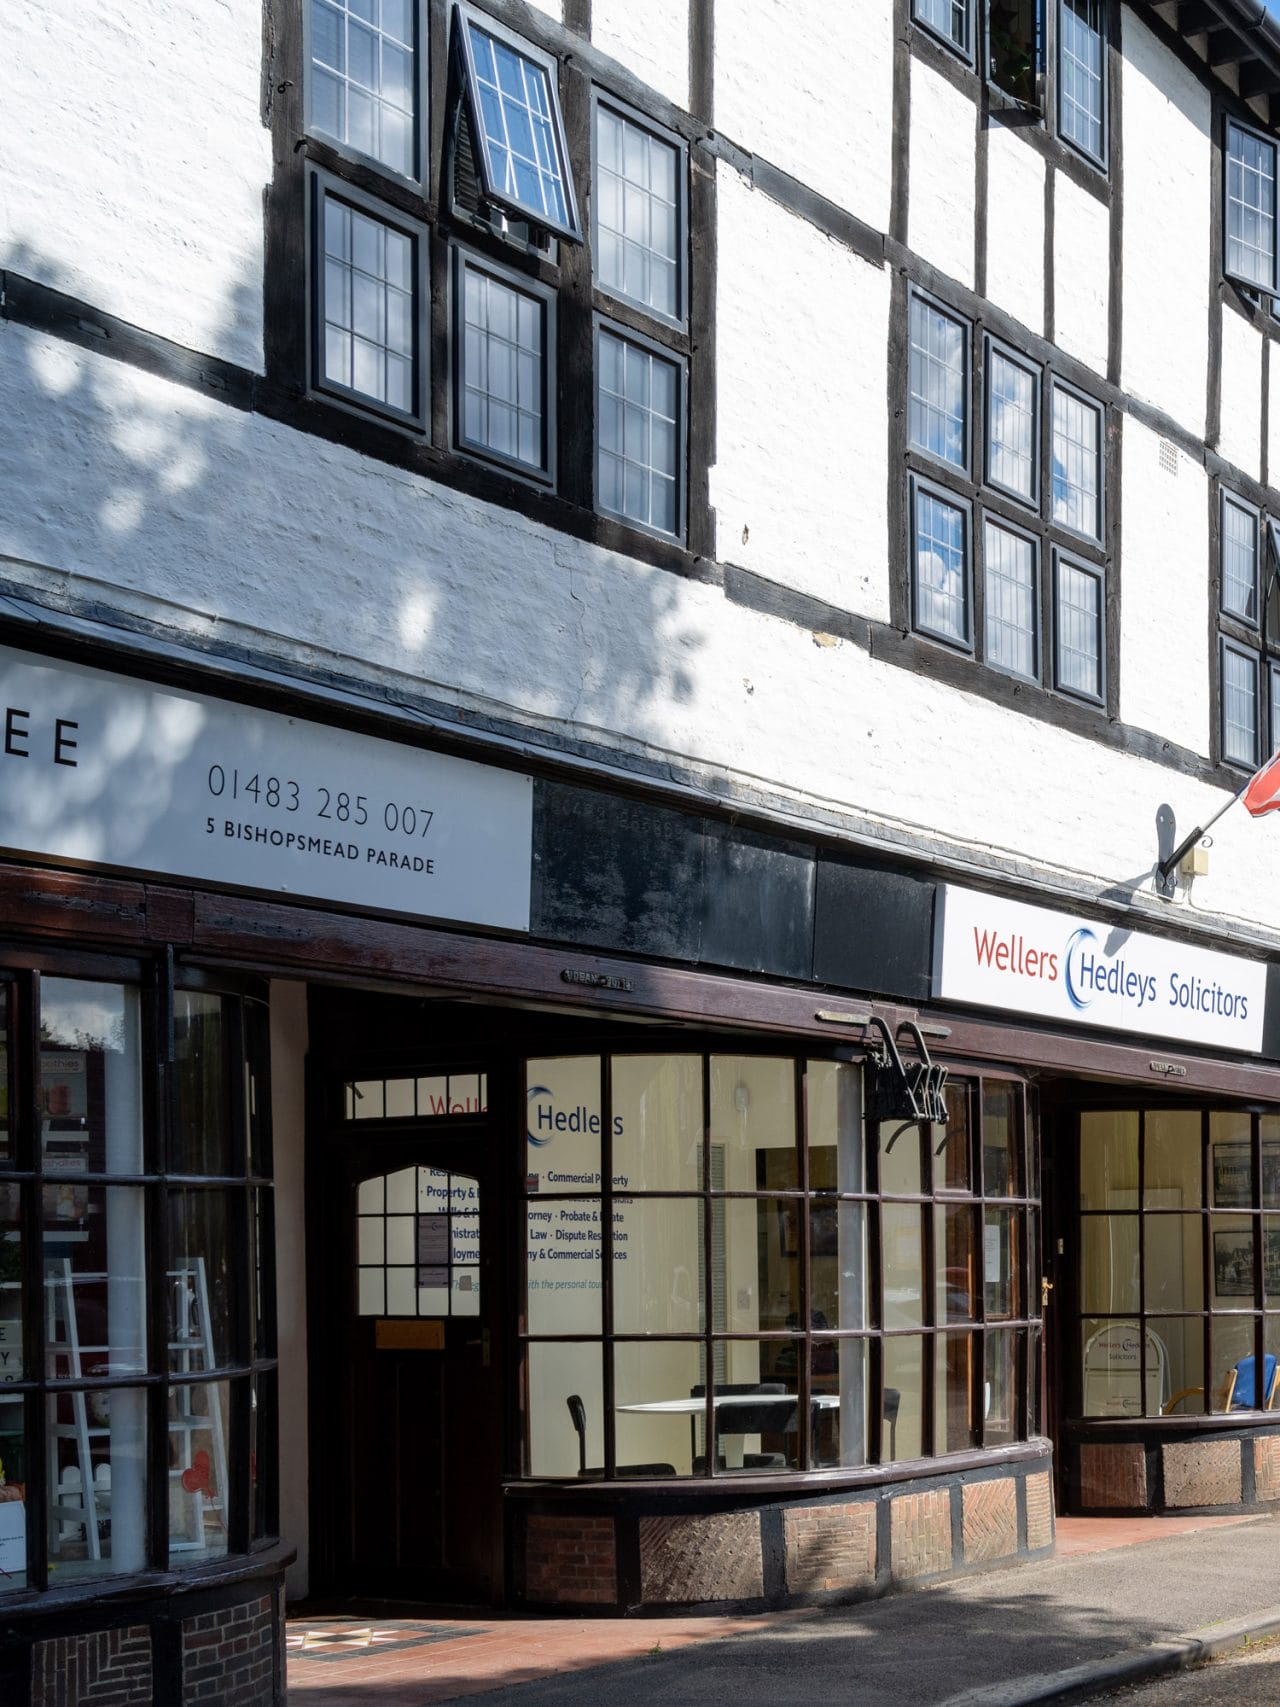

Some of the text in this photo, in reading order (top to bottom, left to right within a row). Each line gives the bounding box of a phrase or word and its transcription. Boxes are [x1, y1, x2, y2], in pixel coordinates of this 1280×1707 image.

[208, 765, 434, 838] 01483 285 007
[206, 817, 435, 875] 5 BISHOPSMEAD PARADE
[973, 926, 1248, 1019] Wellers Hedleys Solicitors
[537, 1104, 624, 1136] Hedles
[547, 1171, 594, 1184] Commercial
[426, 1186, 466, 1199] Property
[560, 1210, 591, 1222] Probate
[530, 1229, 548, 1240] Law
[555, 1229, 587, 1242] Dispute
[547, 1248, 594, 1260] Commercial
[555, 1280, 587, 1291] personal
